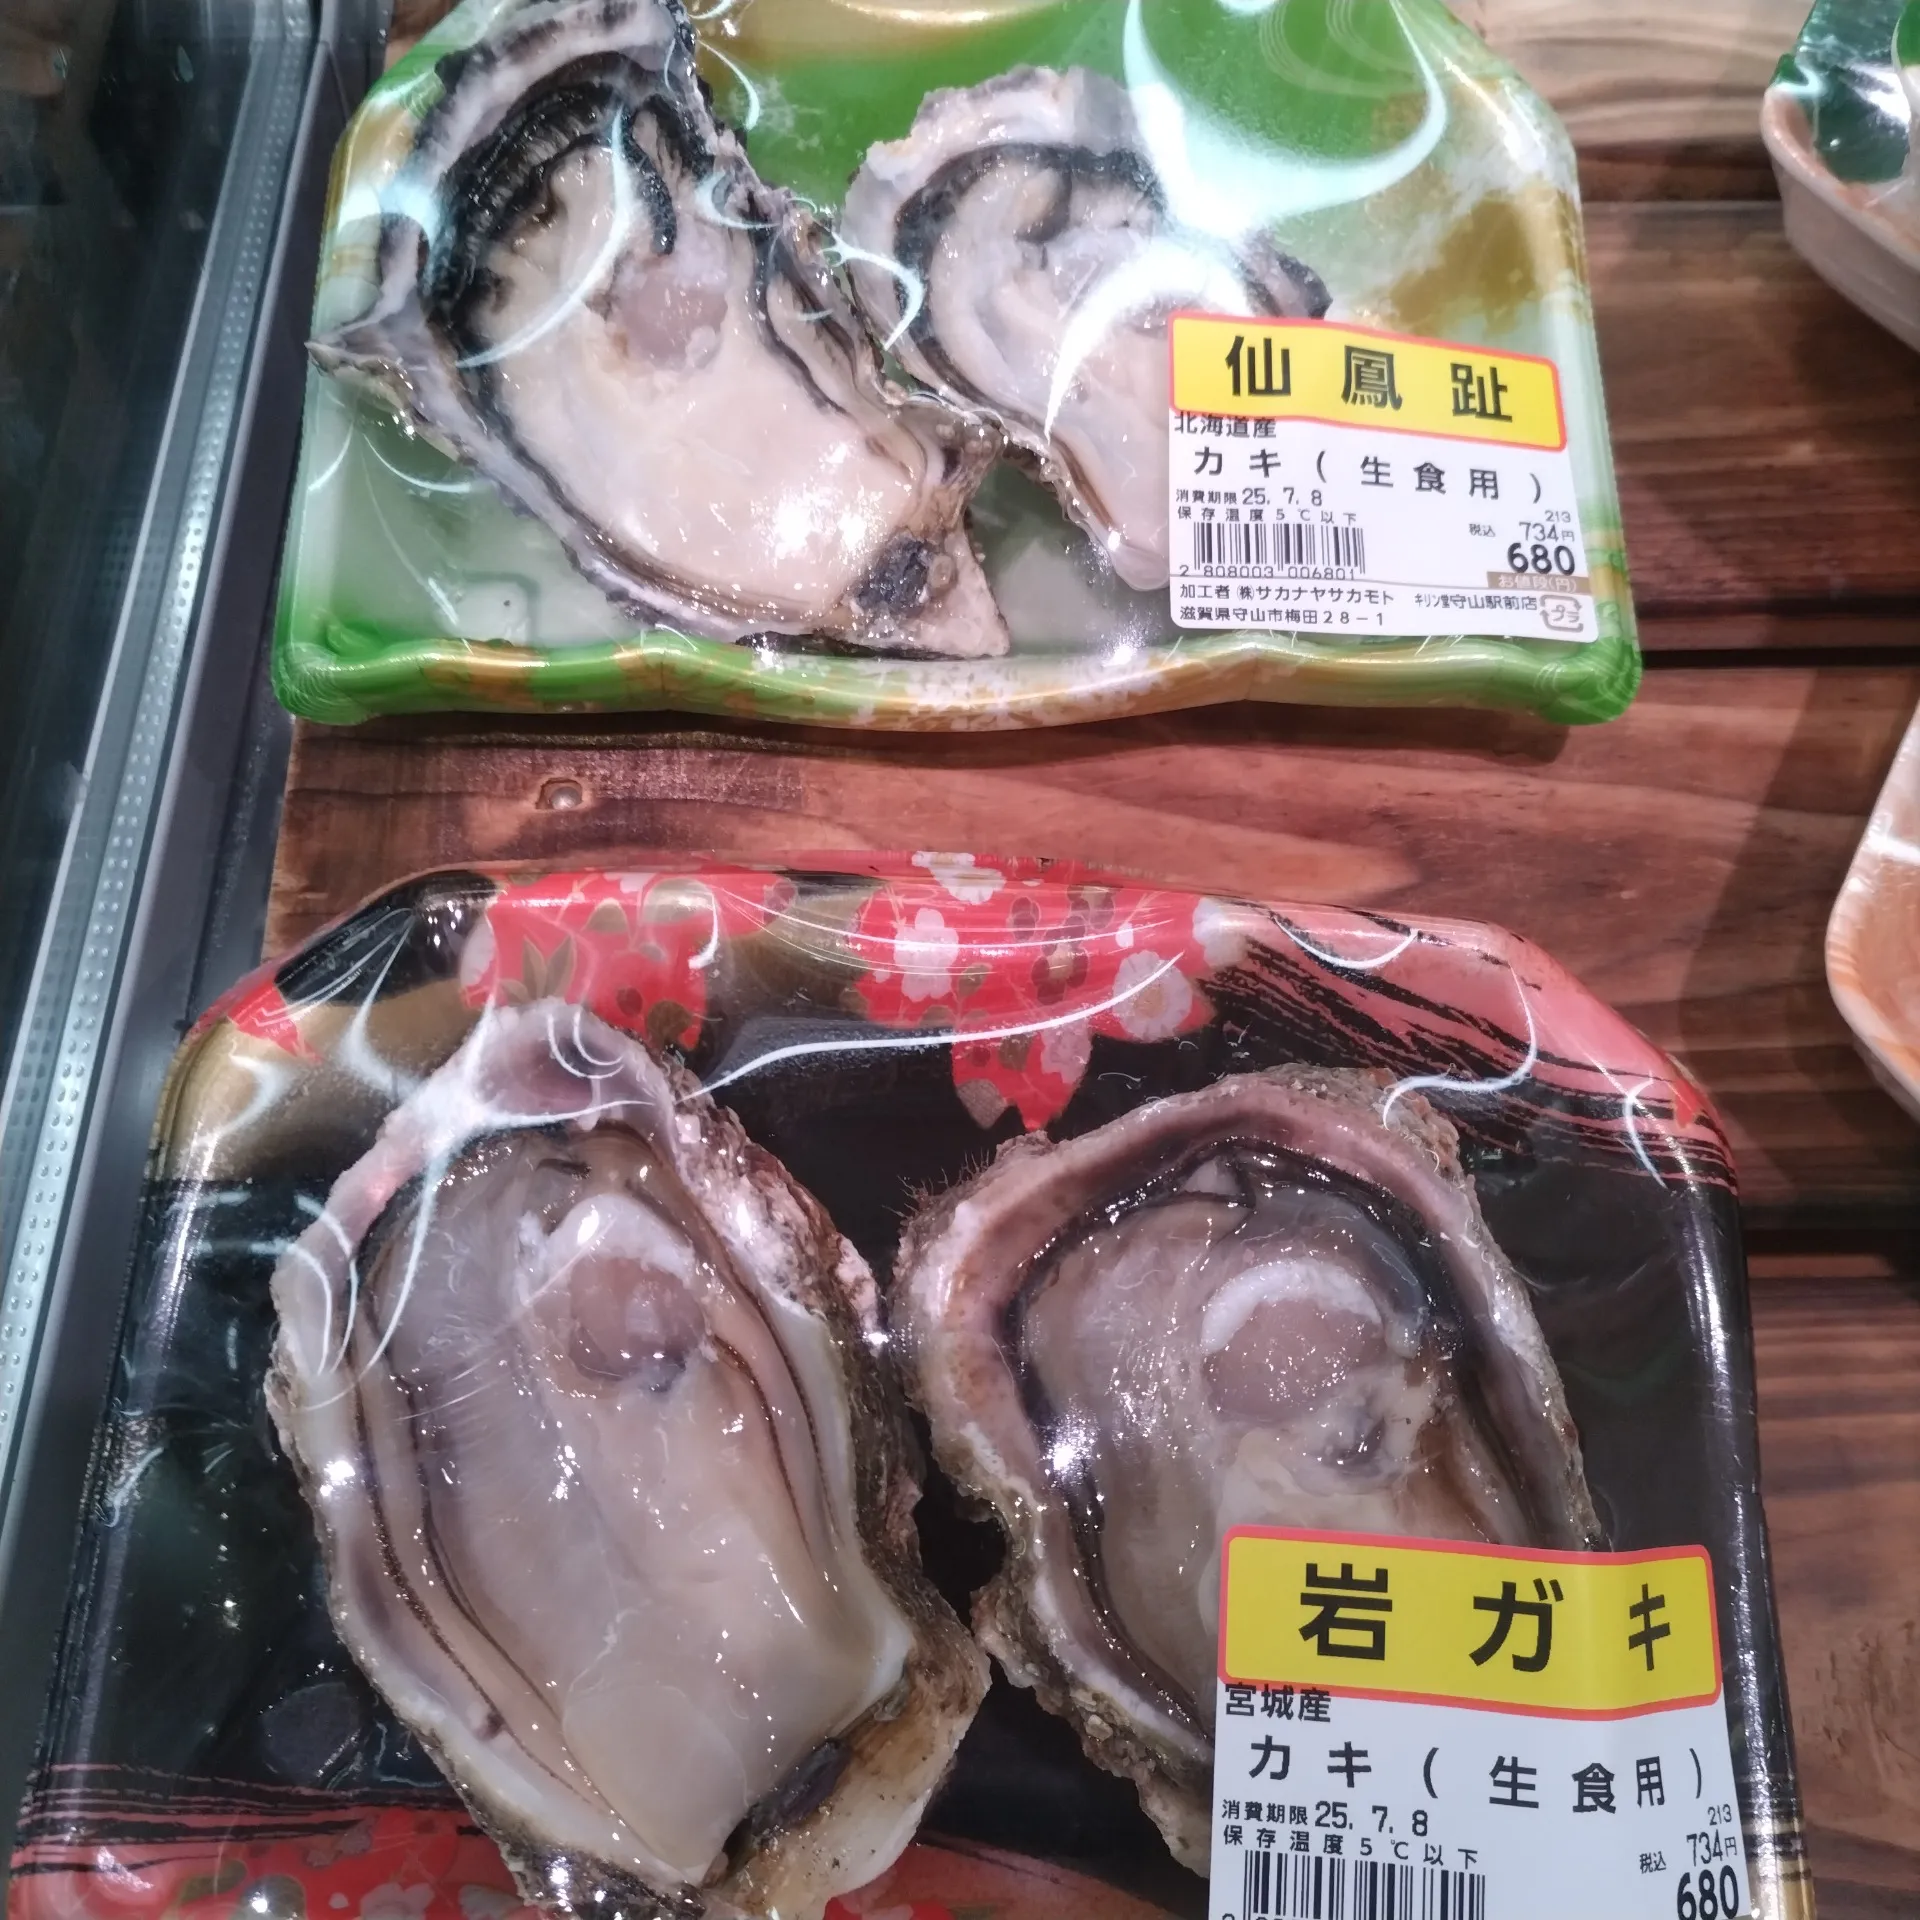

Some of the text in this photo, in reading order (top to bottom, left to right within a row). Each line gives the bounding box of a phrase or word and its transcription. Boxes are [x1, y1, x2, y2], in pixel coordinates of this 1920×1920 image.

[1225, 335, 1513, 423] 仙鳳趾
[1174, 411, 1277, 439] 北海道産
[1544, 510, 1571, 524] 213
[1507, 542, 1576, 576] 680
[1298, 1562, 1671, 1674] 岩ガキ
[1225, 1682, 1332, 1723] 宮城産
[1707, 1803, 1733, 1826] 213
[1639, 1828, 1738, 1875] 税込 734円
[1676, 1864, 1740, 1920] 680
